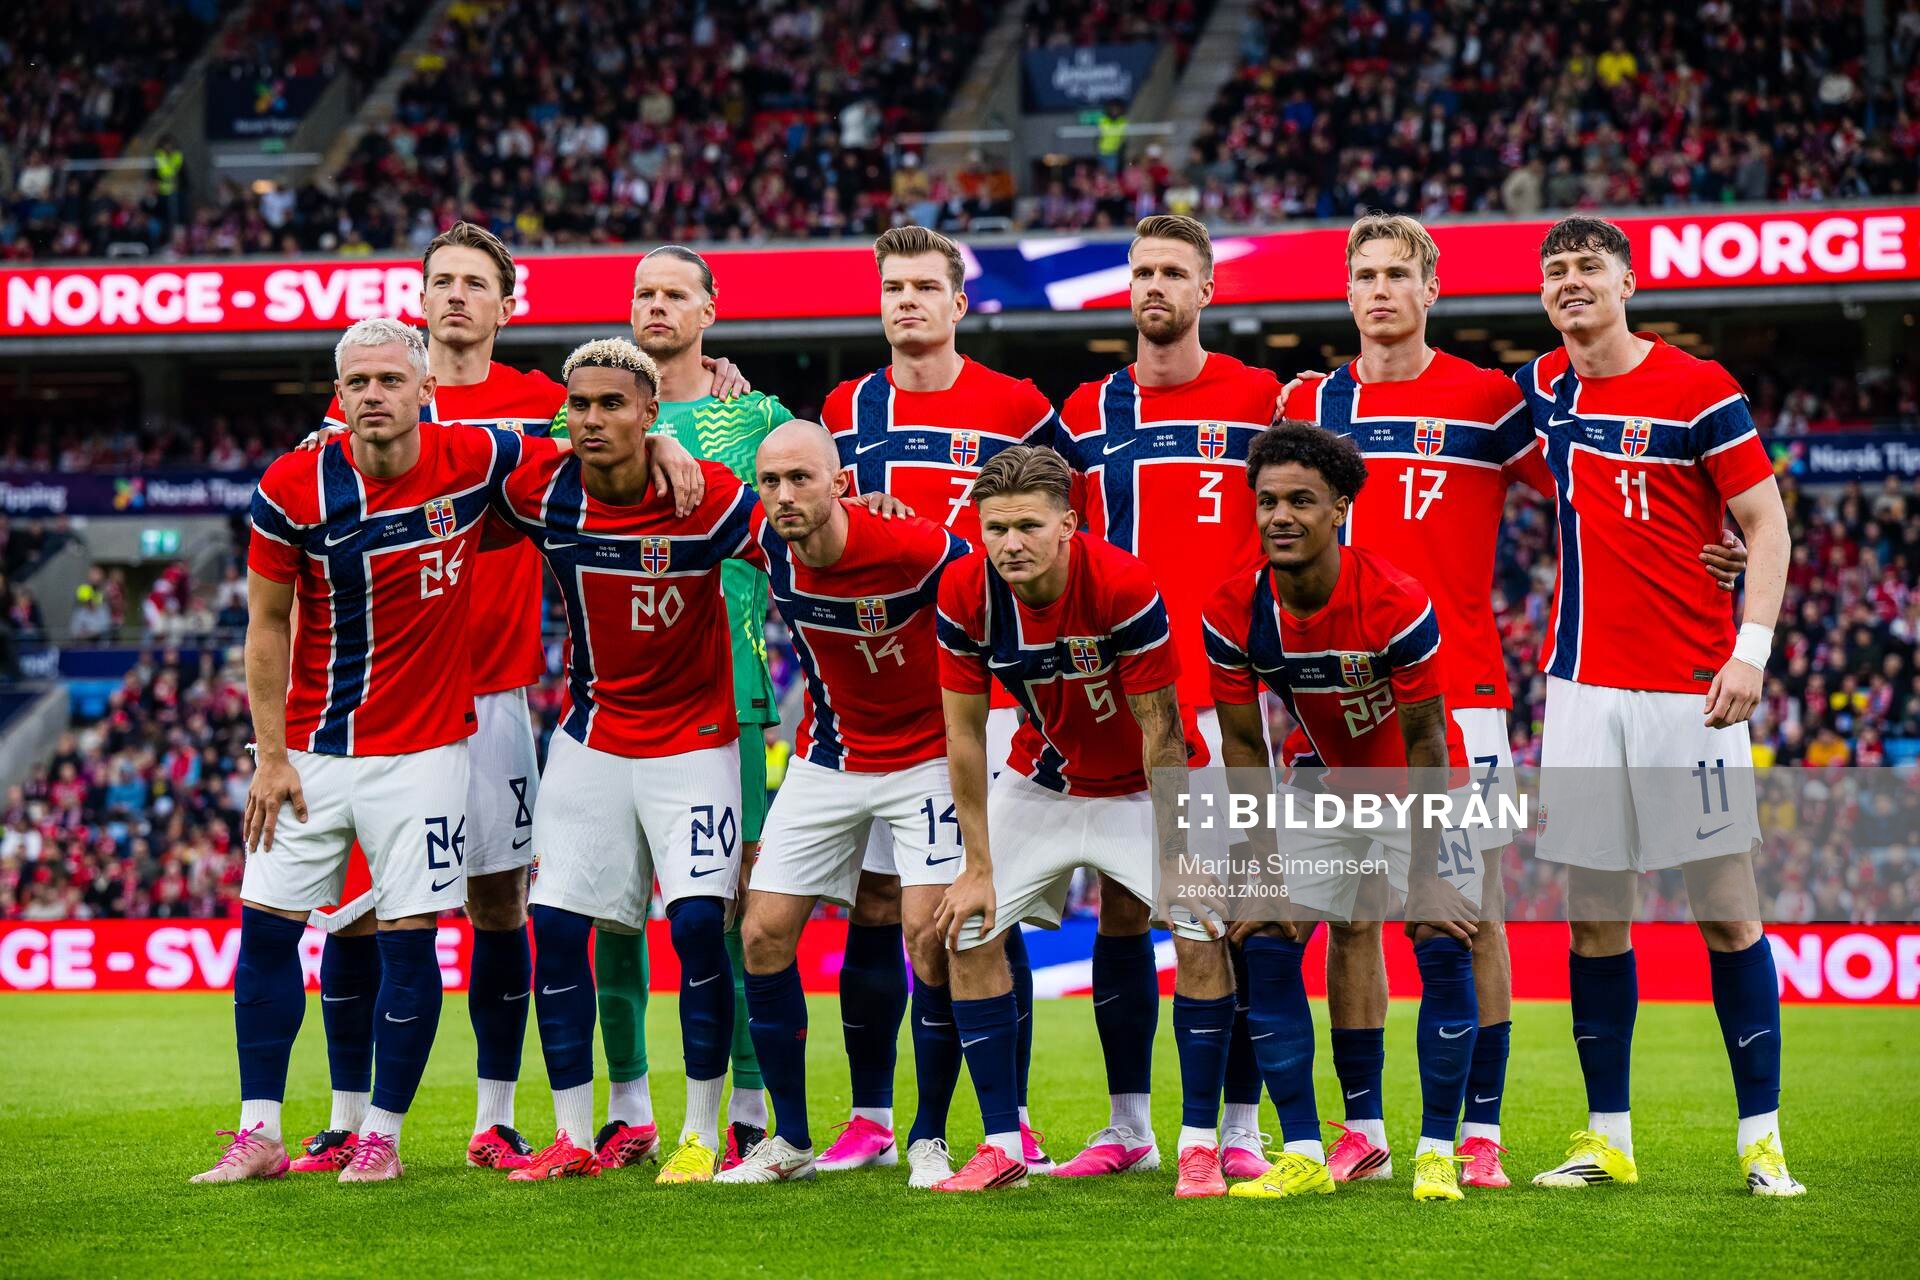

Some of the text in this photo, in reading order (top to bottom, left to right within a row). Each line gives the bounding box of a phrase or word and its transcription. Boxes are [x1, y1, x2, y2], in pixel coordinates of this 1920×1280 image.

[1650, 215, 1906, 280] NORGE
[6, 271, 224, 328] NORGE
[264, 264, 530, 323] SVER
[1809, 443, 1883, 473] Norsk
[147, 479, 208, 507] Norsk
[944, 476, 976, 528] 7
[1197, 470, 1223, 523] 3
[1399, 466, 1447, 520] 17
[1615, 469, 1650, 521] 11
[418, 538, 466, 600] 26
[631, 584, 685, 632] 20
[854, 635, 906, 674] 14
[1084, 679, 1118, 724] 5
[1339, 684, 1396, 739] 22
[508, 776, 533, 829] 8
[1691, 758, 1730, 815] 11
[424, 813, 466, 870] 26
[690, 804, 737, 858] 20
